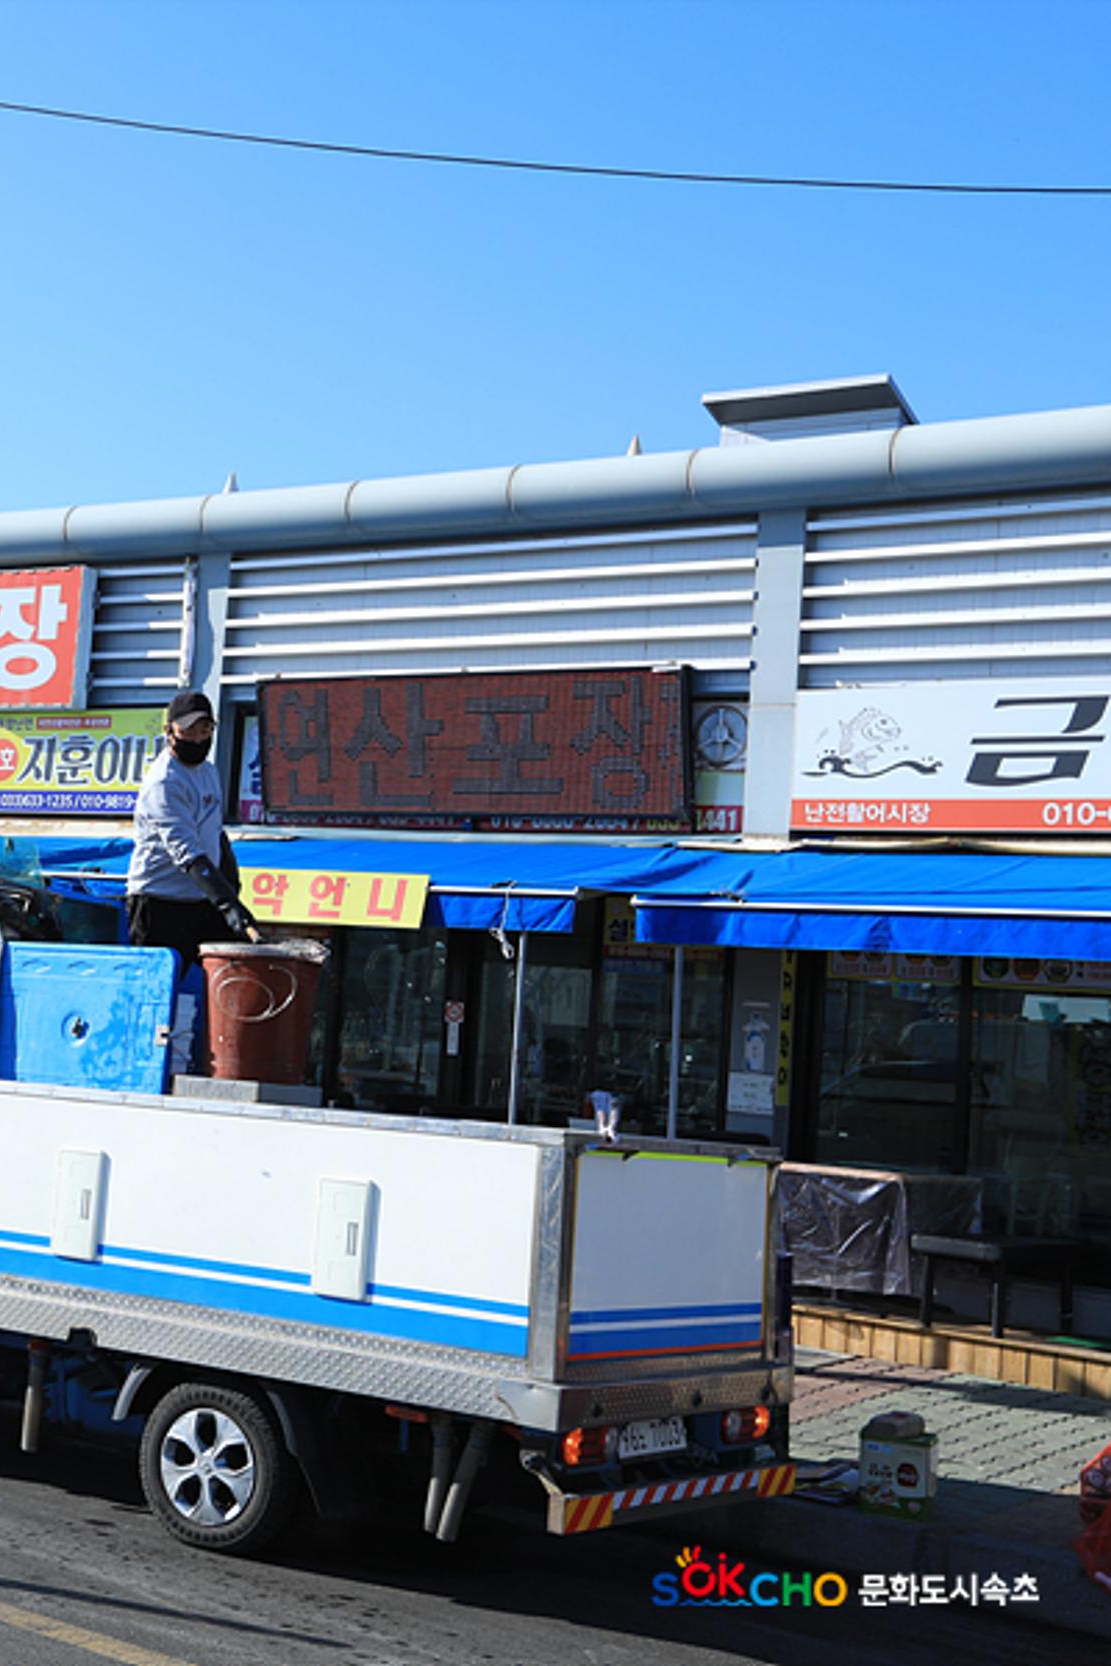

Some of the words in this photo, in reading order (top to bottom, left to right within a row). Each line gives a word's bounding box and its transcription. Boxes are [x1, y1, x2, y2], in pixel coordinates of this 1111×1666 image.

[965, 695, 1109, 787] 금
[804, 801, 932, 825] 난전활어시장
[1043, 801, 1111, 826] 010-
